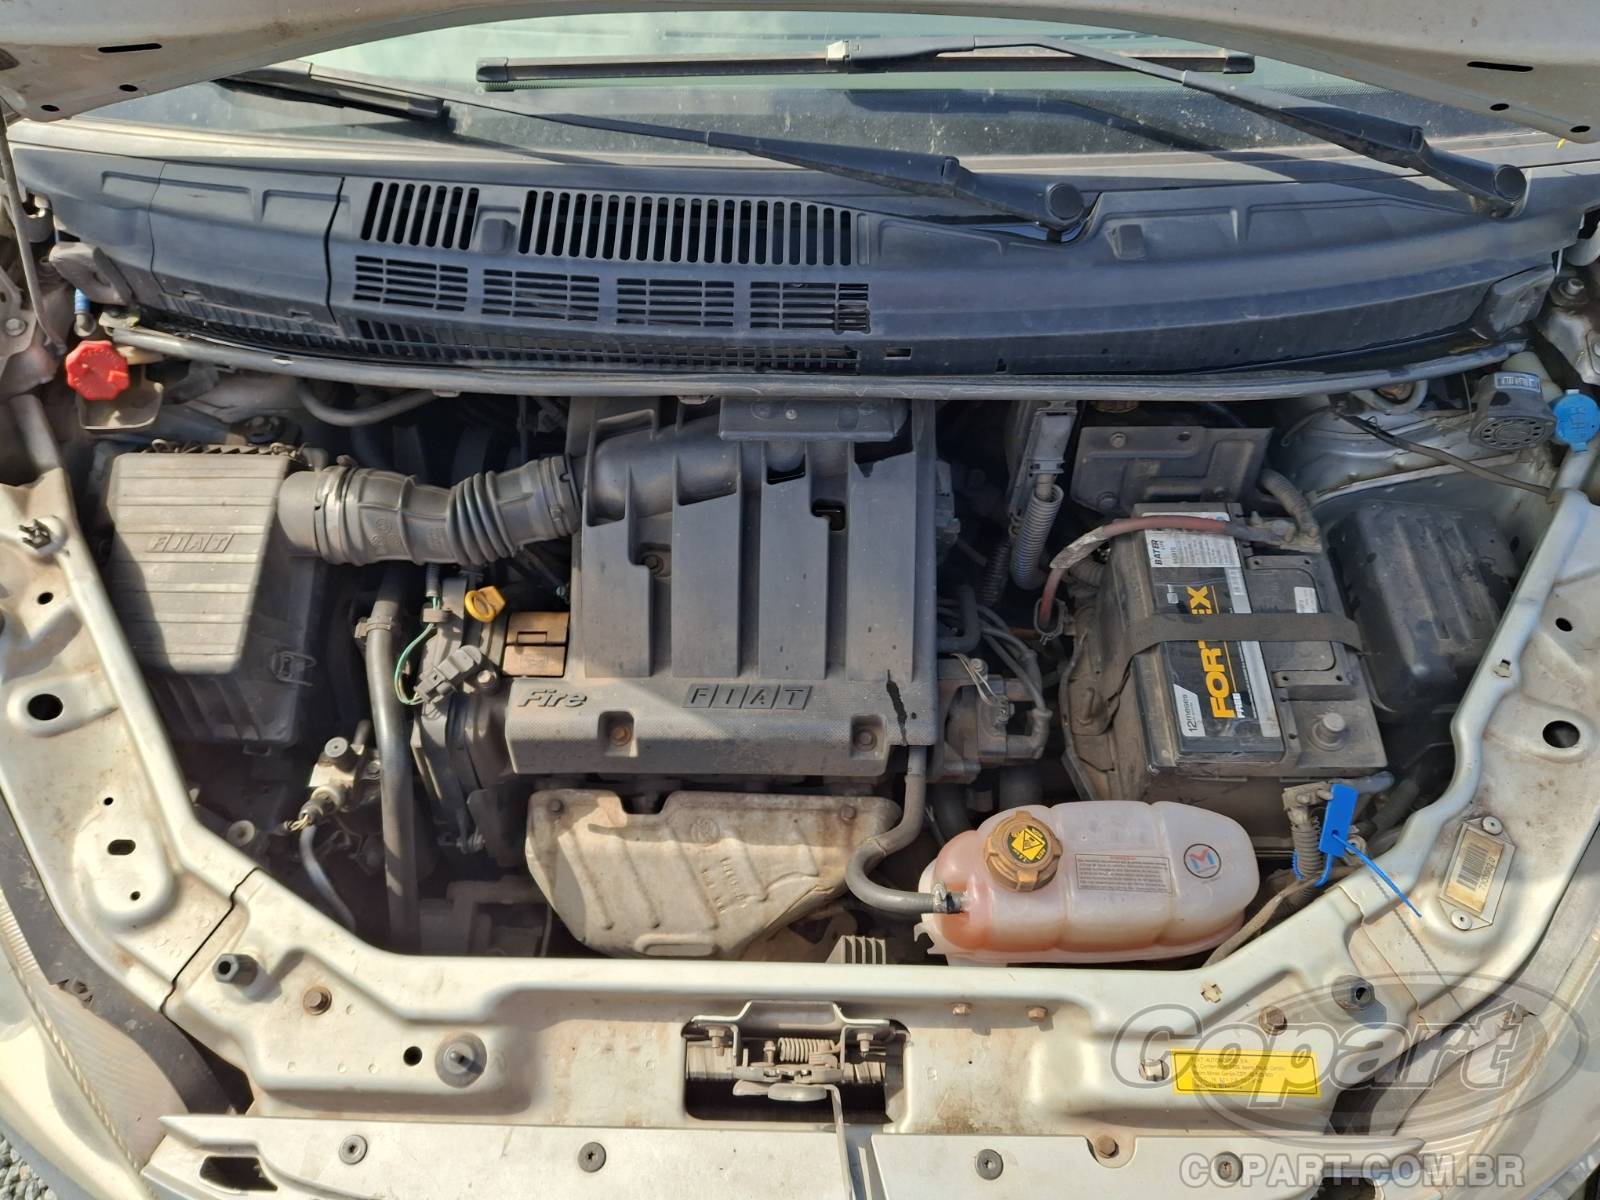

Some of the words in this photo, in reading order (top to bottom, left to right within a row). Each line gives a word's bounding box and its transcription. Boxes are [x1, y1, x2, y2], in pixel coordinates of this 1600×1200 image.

[149, 534, 231, 552] FIAT
[1187, 586, 1236, 718] FORX
[518, 688, 588, 707] Fire
[688, 686, 806, 706] FIAT
